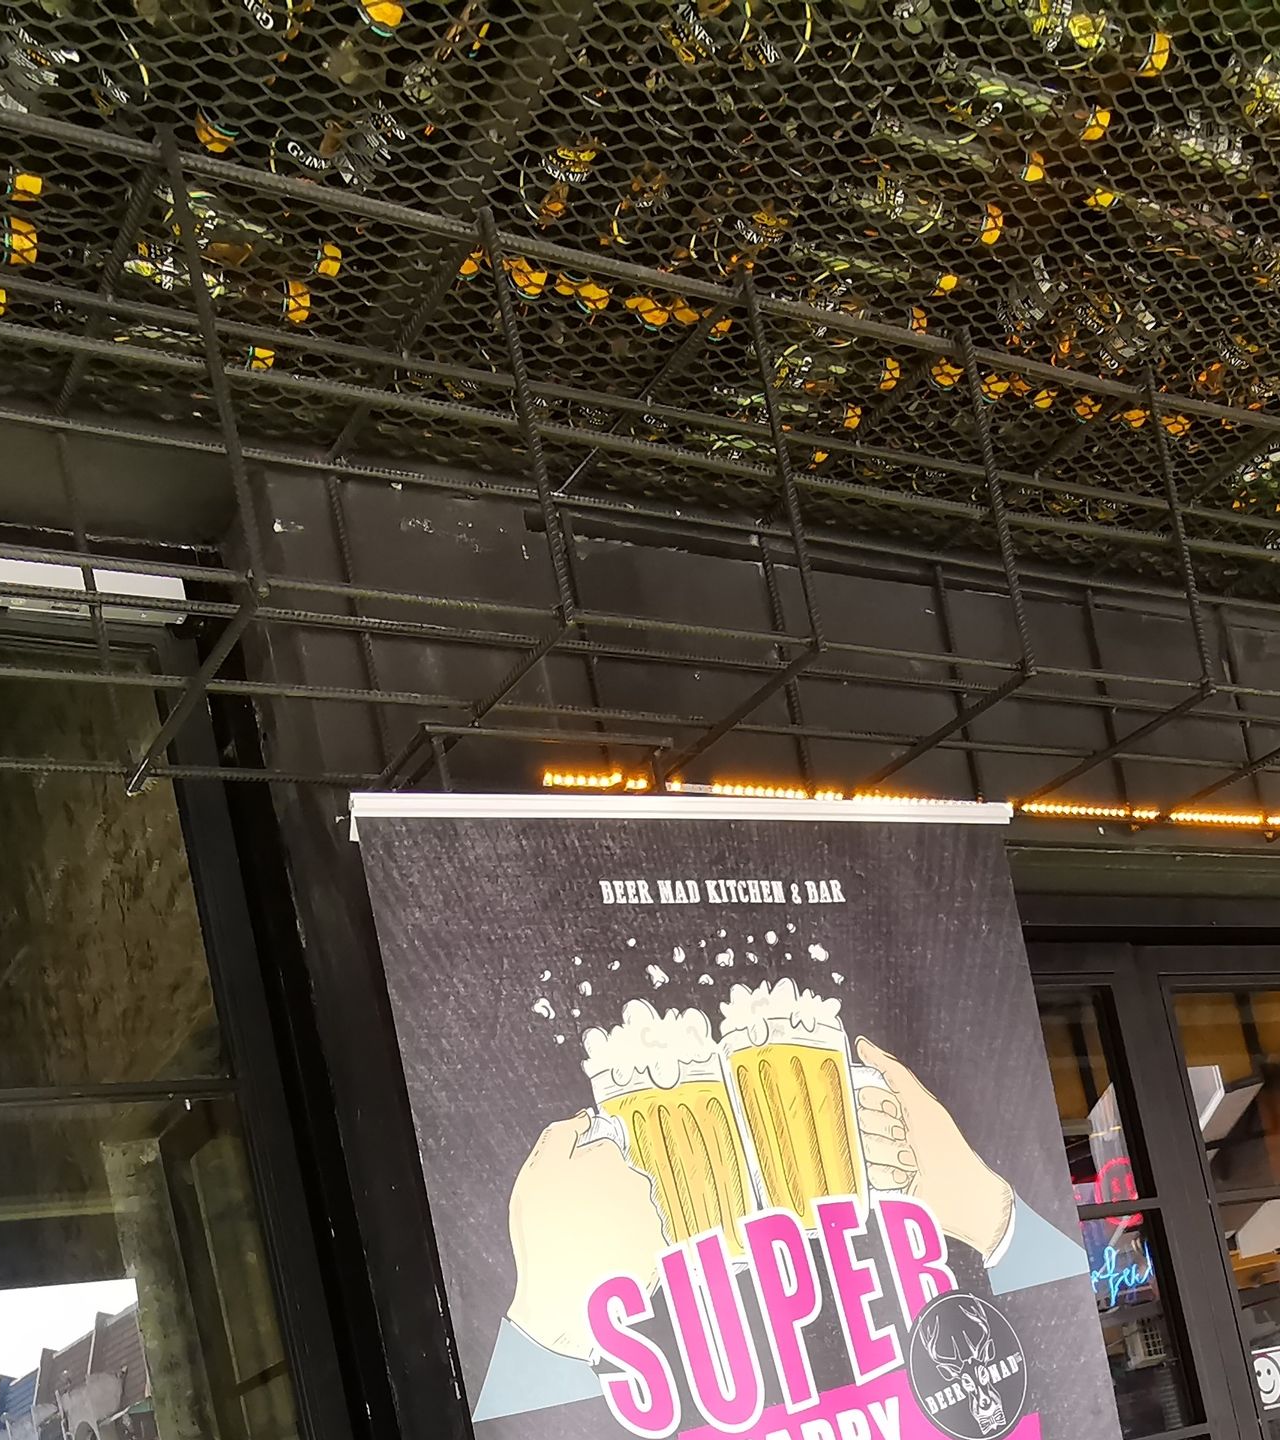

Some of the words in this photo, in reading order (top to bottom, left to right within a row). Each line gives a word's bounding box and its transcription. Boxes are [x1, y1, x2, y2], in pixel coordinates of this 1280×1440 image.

[598, 879, 654, 904] BEER
[657, 880, 701, 904] MAD
[705, 879, 787, 904] KITCHEN
[790, 883, 802, 904] &
[804, 879, 847, 904] BAR
[585, 1196, 958, 1437] SUPER
[925, 1382, 967, 1415] BEER
[988, 1354, 1019, 1384] MAD
